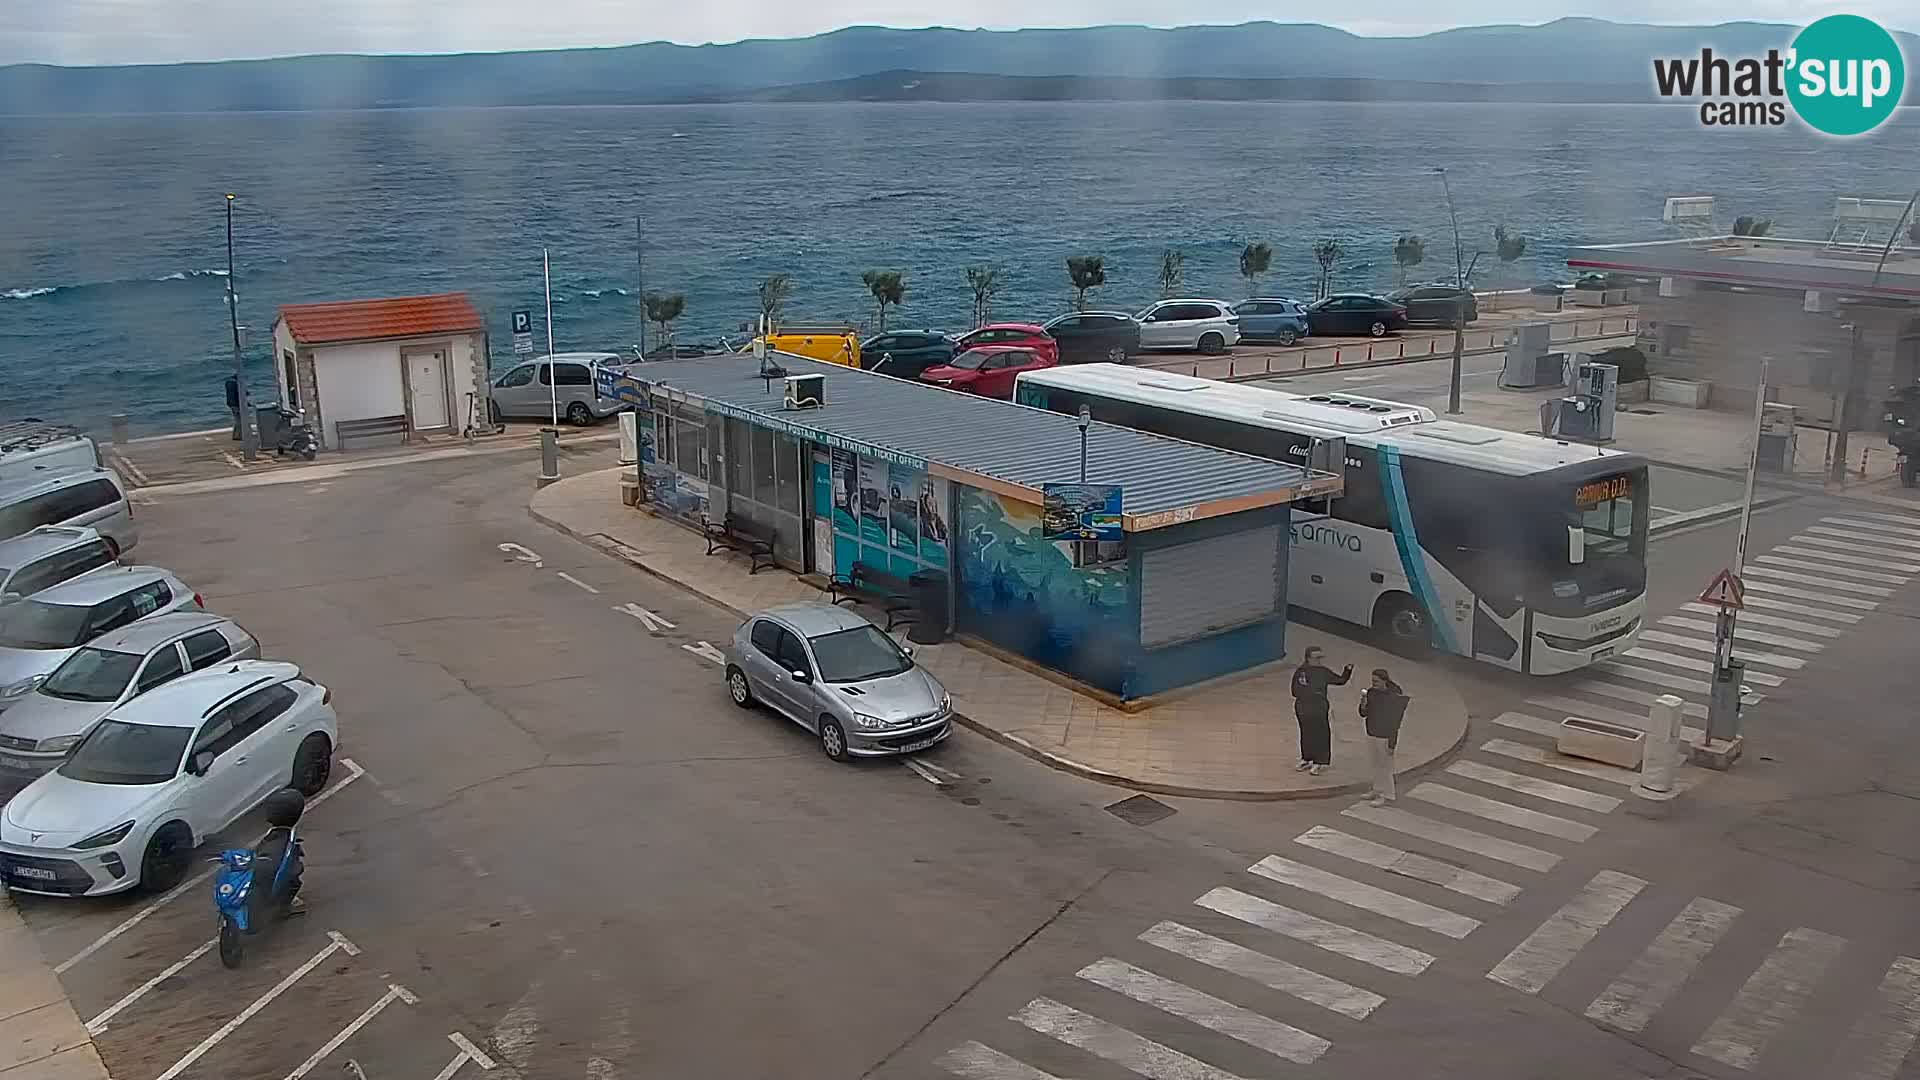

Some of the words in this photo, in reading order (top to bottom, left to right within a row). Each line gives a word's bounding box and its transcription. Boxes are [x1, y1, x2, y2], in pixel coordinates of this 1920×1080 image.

[516, 314, 527, 330] P
[788, 422, 817, 440] POSTAJA
[826, 434, 841, 447] BUS
[841, 438, 871, 455] STATION
[873, 447, 898, 462] TICKET
[899, 453, 925, 470] OFFICE
[1301, 523, 1362, 552] arriva
